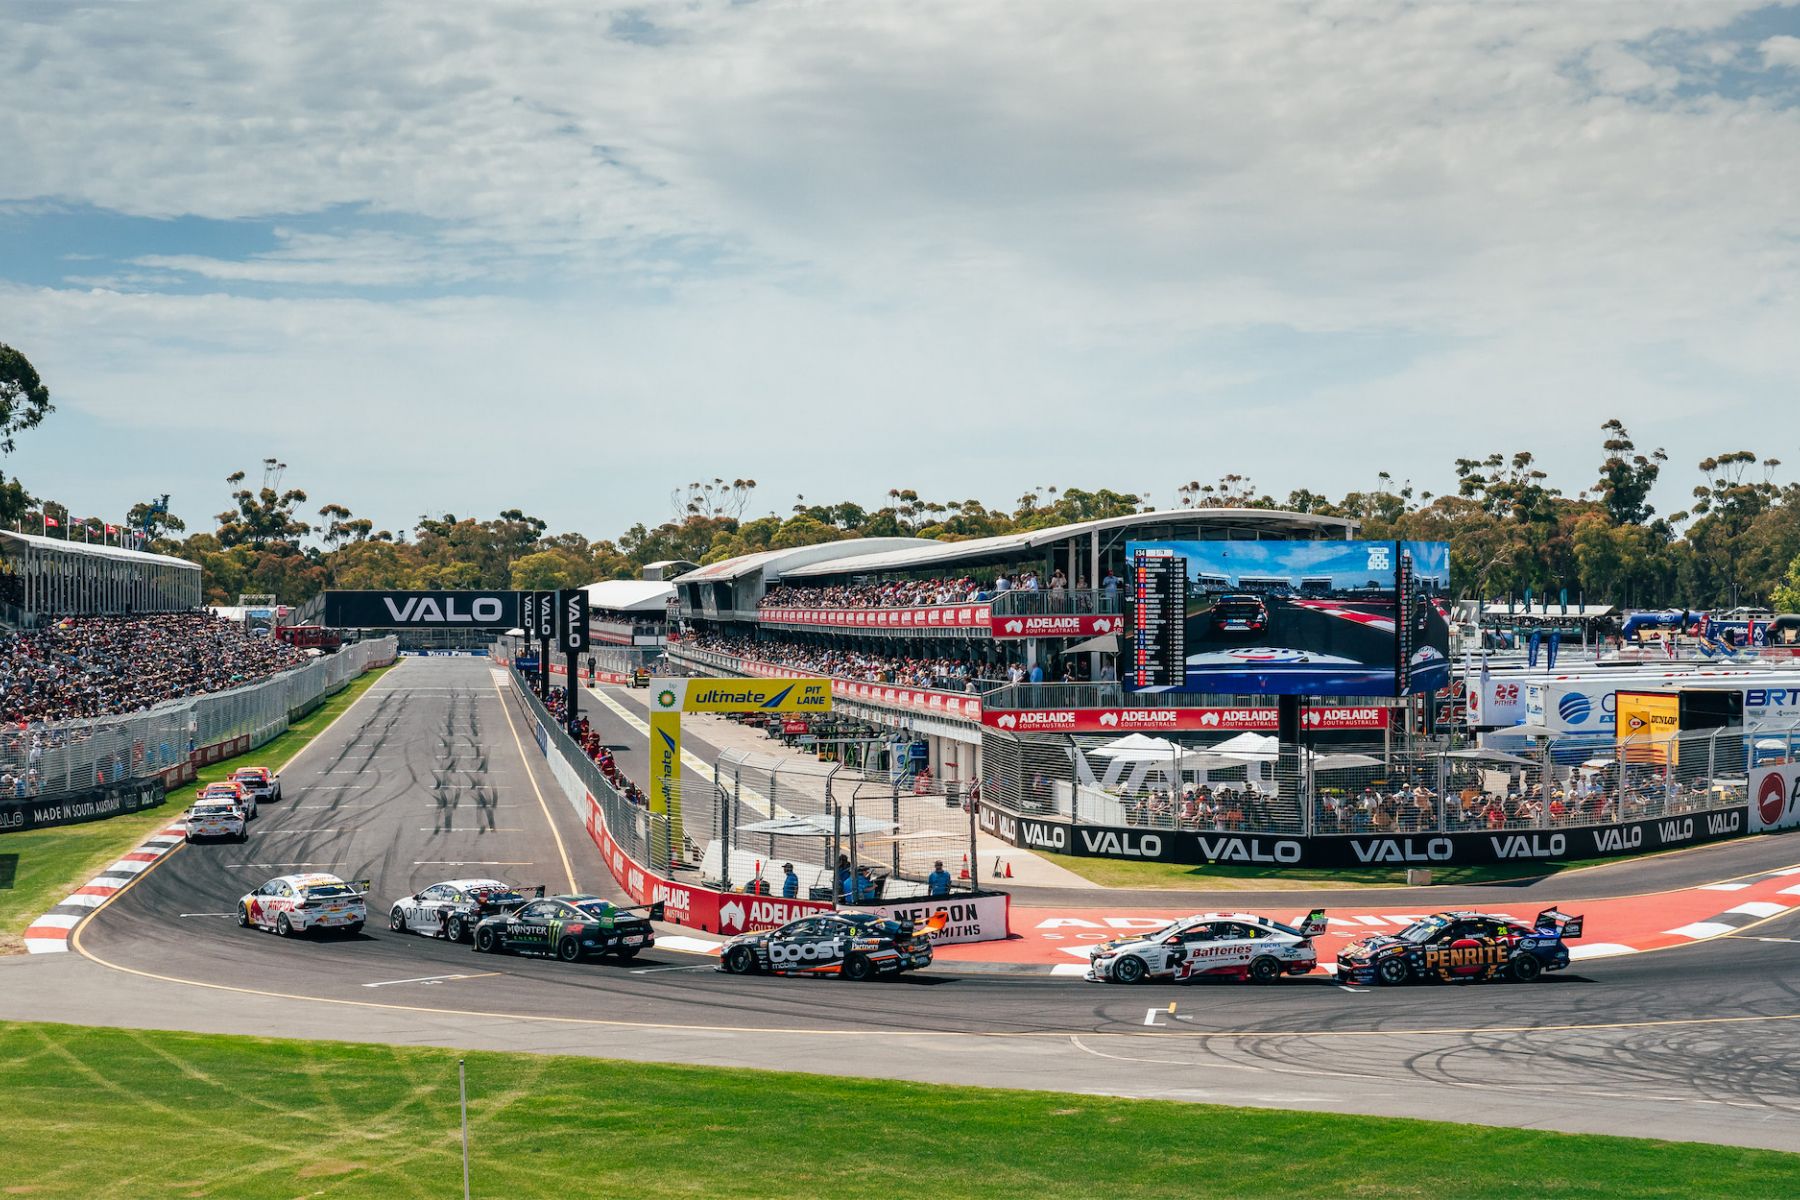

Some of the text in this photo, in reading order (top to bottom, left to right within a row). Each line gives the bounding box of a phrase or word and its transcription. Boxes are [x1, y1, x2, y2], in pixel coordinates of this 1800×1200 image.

[383, 598, 502, 622] VALO
[524, 596, 532, 627] VALO
[542, 596, 550, 635] VALO
[568, 595, 580, 648] VALO
[1026, 618, 1080, 628] ADELAIDE
[696, 690, 766, 704] ultimate
[805, 686, 822, 694] PIT
[1496, 684, 1519, 700] 22
[796, 696, 826, 704] LANE
[1020, 712, 1076, 723] ADELAIDE
[1122, 711, 1177, 721] ADELAIDE
[1223, 710, 1278, 721] ADELAIDE
[1324, 710, 1378, 720] ADELAIDE
[1650, 715, 1678, 725] DUNLOP
[34, 806, 61, 822] MADE
[63, 806, 72, 818] IN
[72, 802, 94, 817] SOUTH
[96, 798, 120, 813] AUSTRALIA
[982, 806, 995, 831] VALO
[1000, 814, 1016, 841] VALO
[1022, 818, 1065, 848] VALO
[1658, 818, 1694, 843] VALO
[1707, 812, 1740, 836] VALO
[1082, 830, 1162, 856] VALO
[1490, 834, 1566, 858] VALO
[1593, 826, 1642, 850] VALO
[1198, 837, 1301, 864] VALO
[1351, 838, 1453, 862] VALO
[405, 907, 437, 922] OPTUS
[507, 924, 548, 936] MONSTER
[850, 928, 855, 936] 9
[1250, 930, 1255, 938] 8
[1310, 924, 1326, 932] 3M
[769, 937, 844, 962] boost
[1192, 944, 1252, 957] Batteries
[1378, 949, 1392, 958] JAX
[1426, 945, 1508, 968] PENRITE
